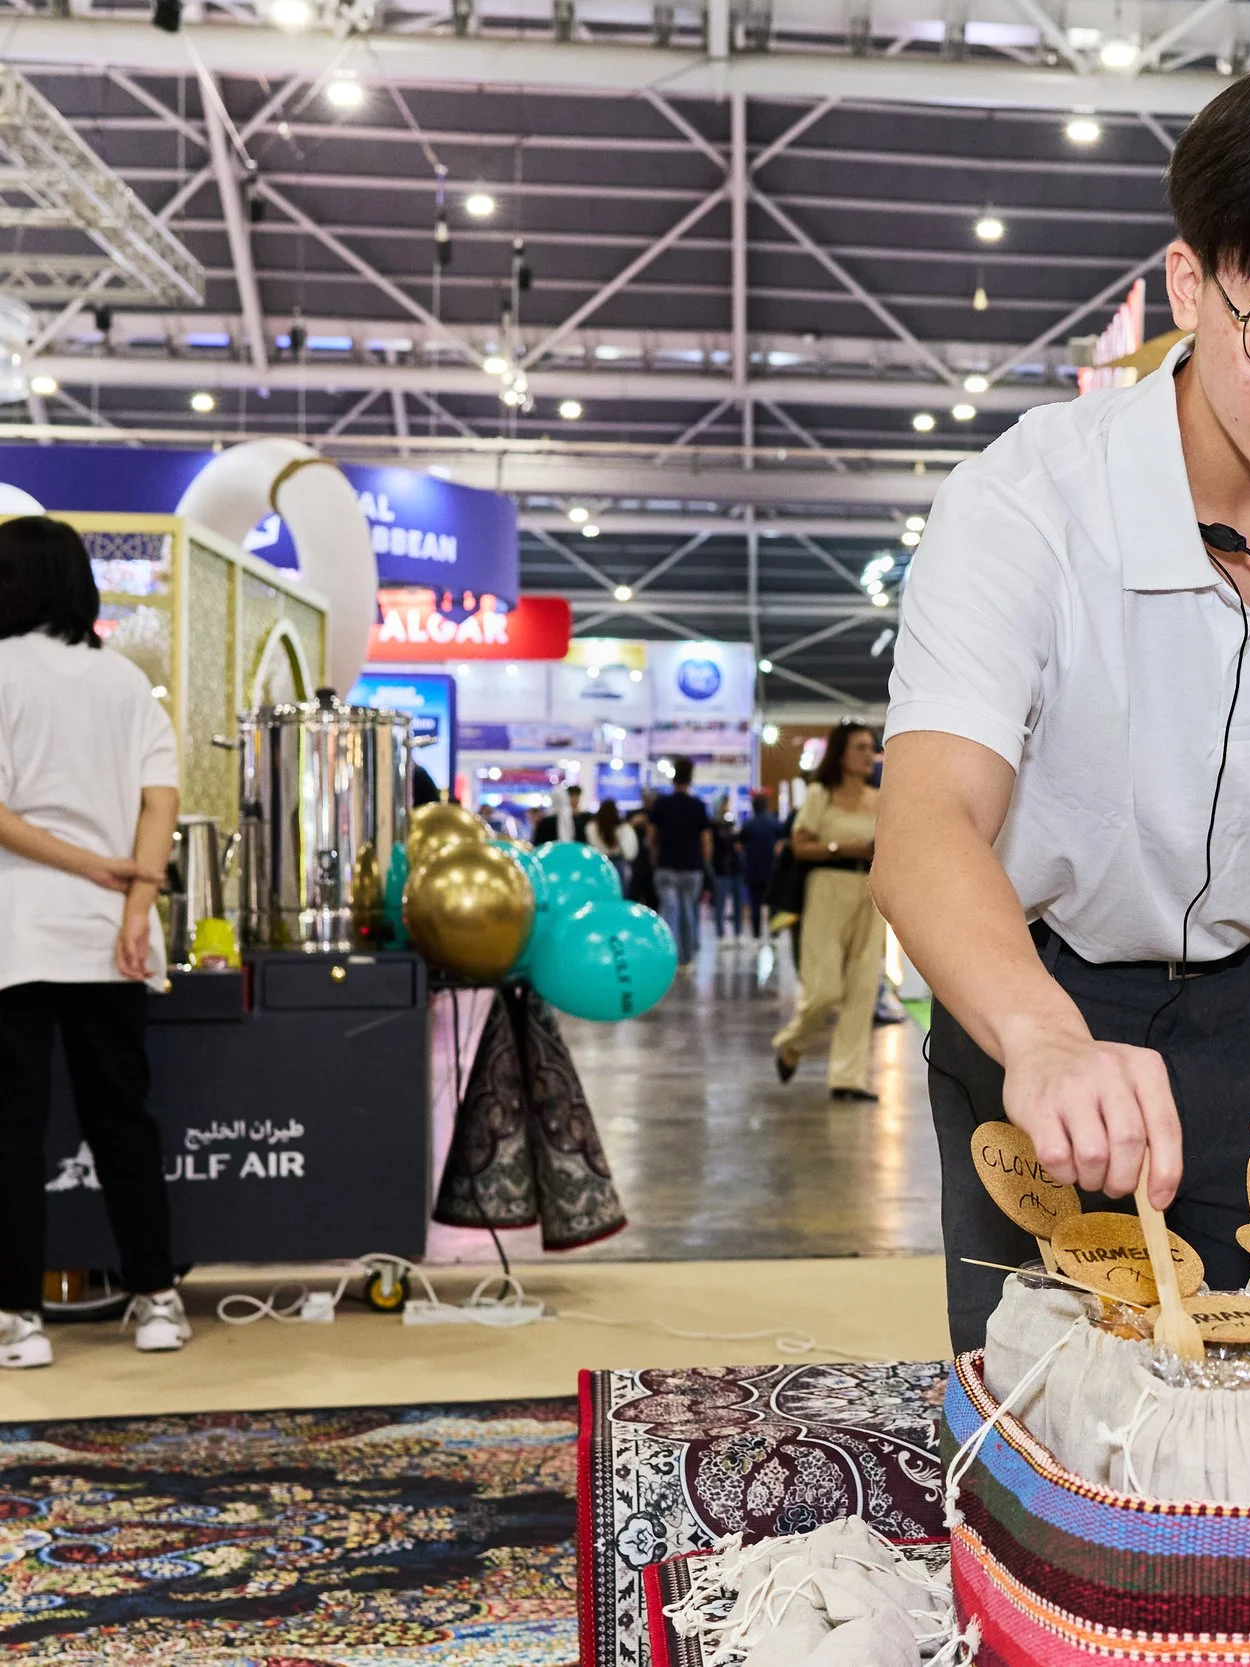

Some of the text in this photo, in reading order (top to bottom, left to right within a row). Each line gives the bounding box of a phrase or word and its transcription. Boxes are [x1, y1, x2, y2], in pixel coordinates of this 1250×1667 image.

[359, 491, 395, 523] AL
[371, 525, 457, 564] BBEAN
[377, 609, 509, 645] ALGAR
[183, 1118, 305, 1150] طيران الخليج
[163, 1150, 306, 1182] ULF AIR
[982, 1145, 1064, 1189] CLOVE
[1063, 1246, 1185, 1264] TURMEC
